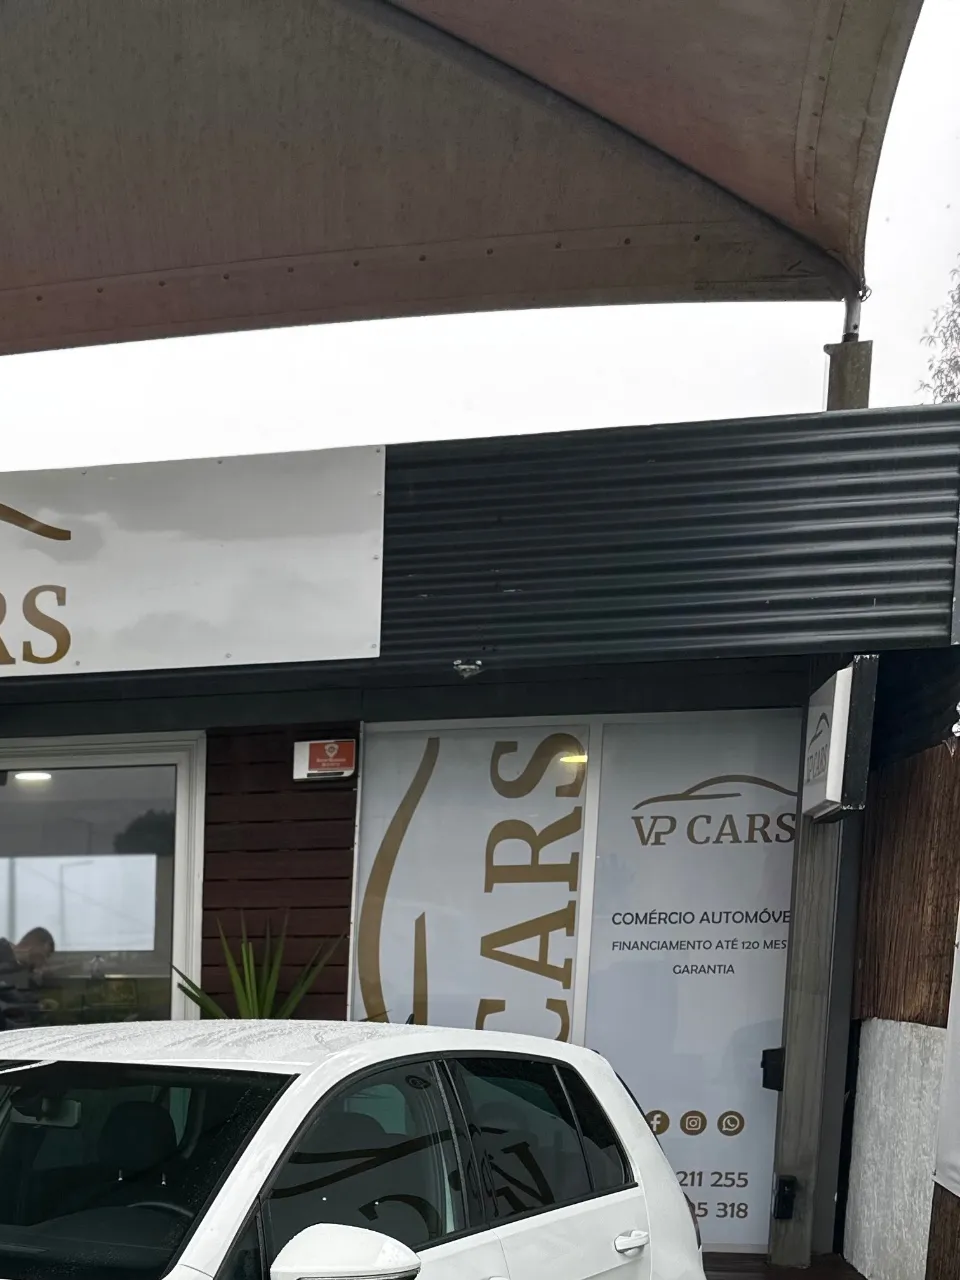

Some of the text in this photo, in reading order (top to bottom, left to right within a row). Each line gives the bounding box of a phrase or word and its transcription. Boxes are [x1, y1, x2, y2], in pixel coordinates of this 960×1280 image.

[631, 812, 796, 846] VP CARS
[611, 909, 695, 925] COMÉRCIO
[611, 939, 713, 951] FINANCIAMENTO
[715, 938, 739, 950] ATÉ
[741, 940, 760, 950] 120
[672, 964, 735, 975] GARANTIA
[710, 1171, 748, 1188] 255
[716, 1202, 748, 1219] 318
